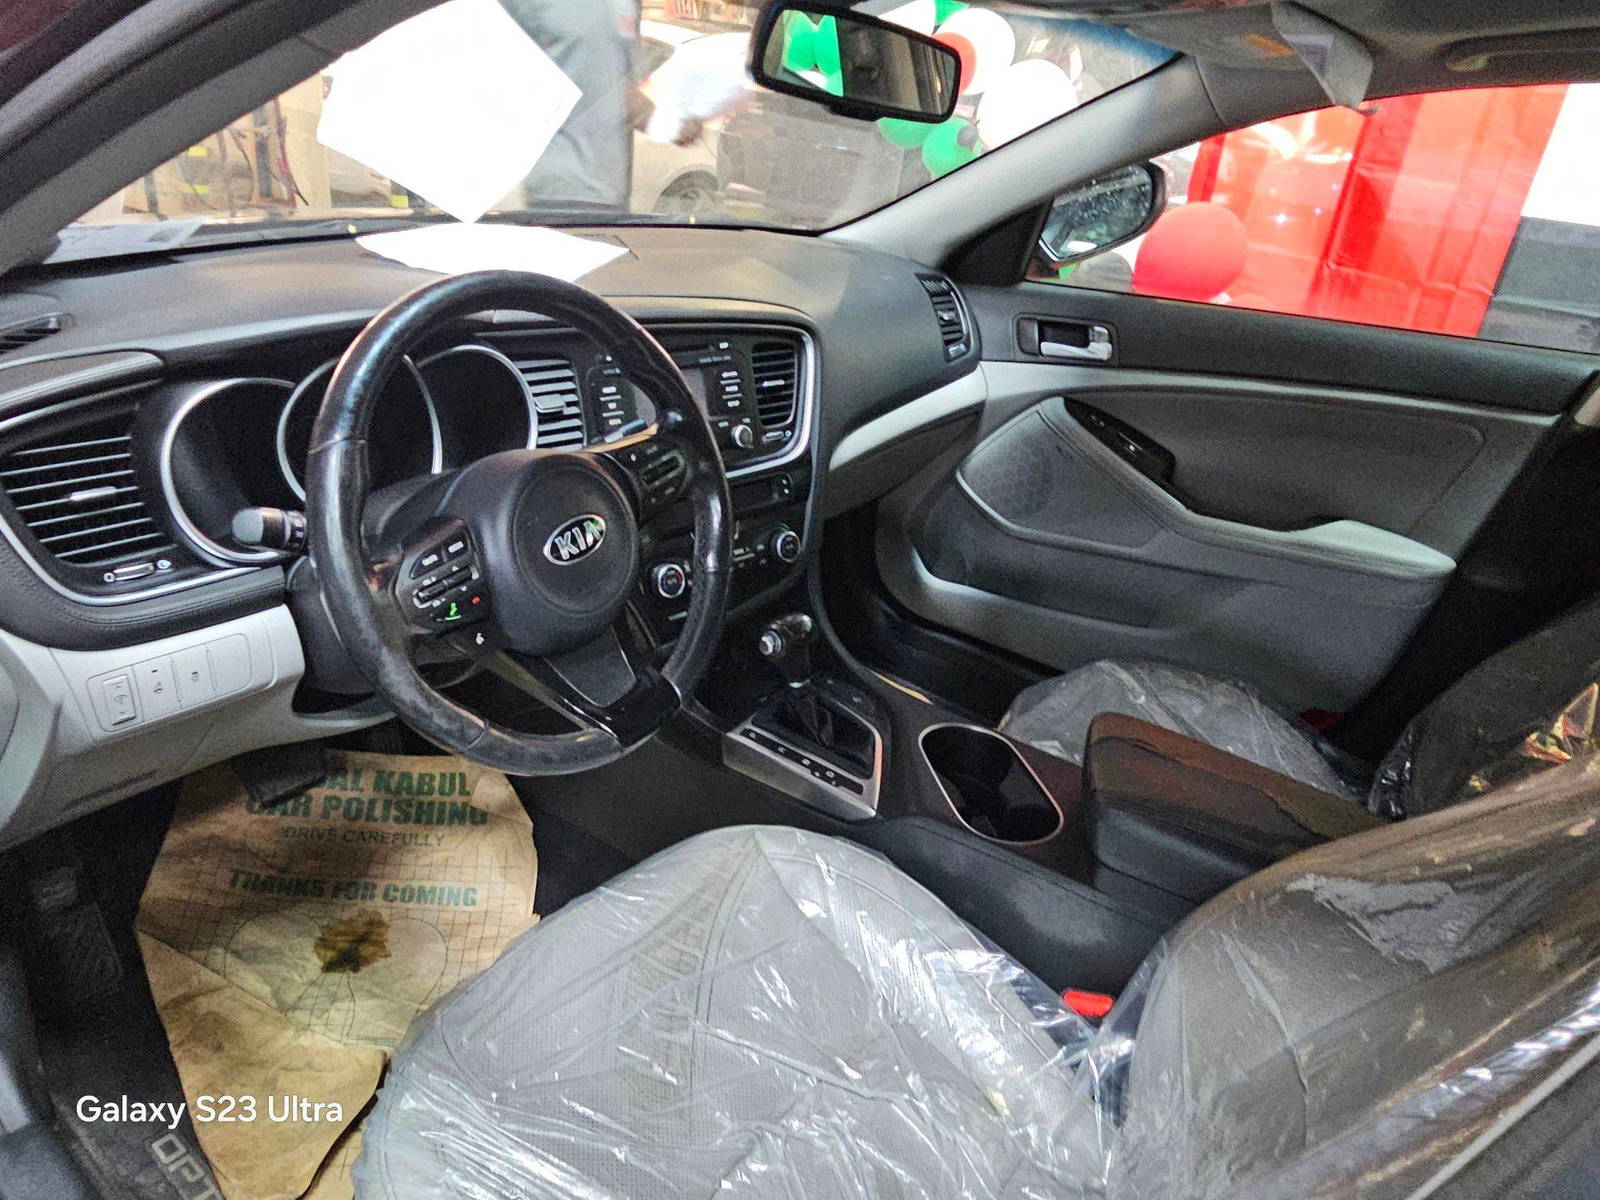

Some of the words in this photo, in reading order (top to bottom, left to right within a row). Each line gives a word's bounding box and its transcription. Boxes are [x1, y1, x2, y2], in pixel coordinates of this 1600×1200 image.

[553, 519, 602, 560] KIA
[373, 770, 470, 795] KABUL
[321, 795, 489, 825] POLISHING
[343, 830, 445, 846] CAREFULLY
[229, 872, 324, 897] THANKS
[331, 879, 377, 900] FOR
[382, 883, 478, 906] COMING
